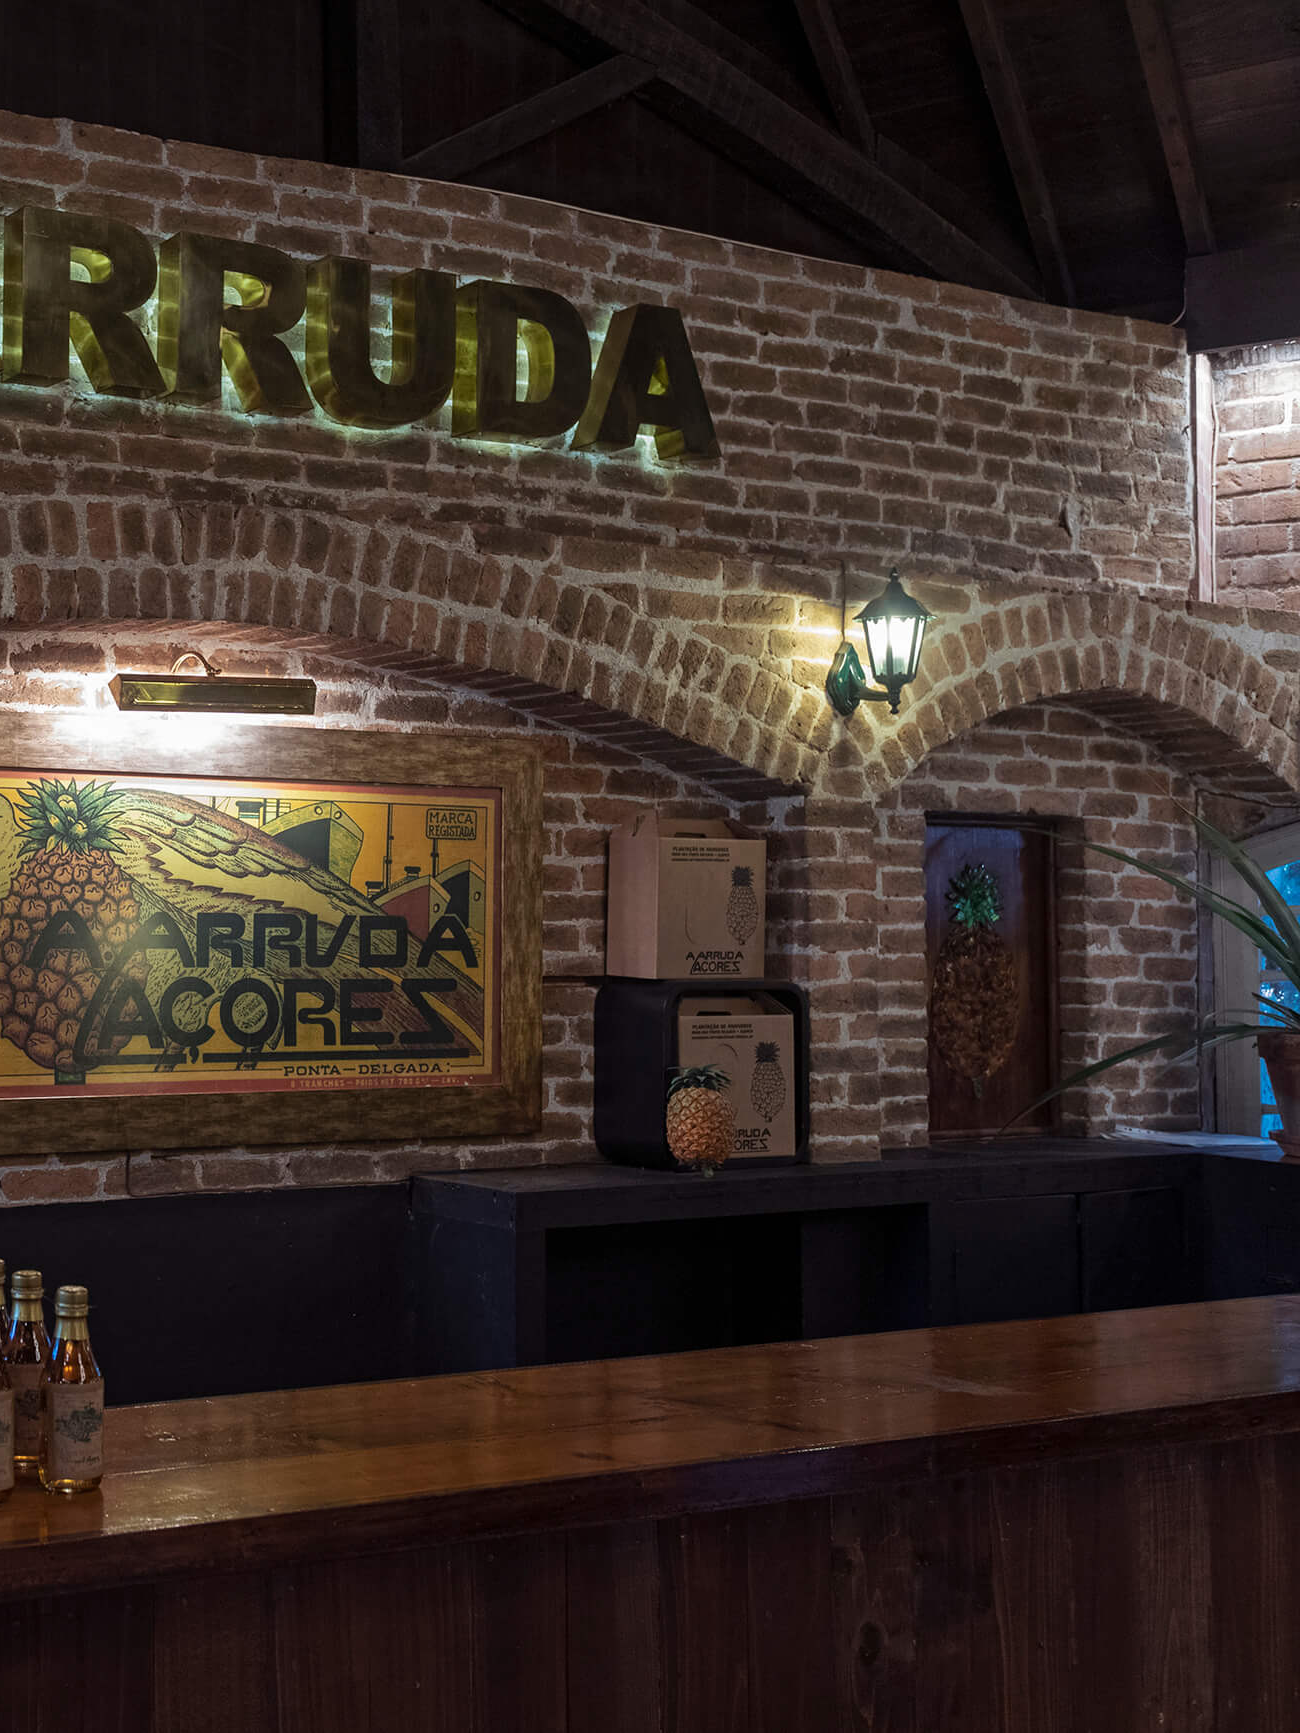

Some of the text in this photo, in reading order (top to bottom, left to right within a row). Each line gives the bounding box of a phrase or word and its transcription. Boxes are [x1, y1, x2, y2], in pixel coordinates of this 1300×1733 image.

[429, 811, 474, 825] MARCA
[428, 824, 475, 838] REGISTADA
[696, 951, 745, 961] ARRUDA
